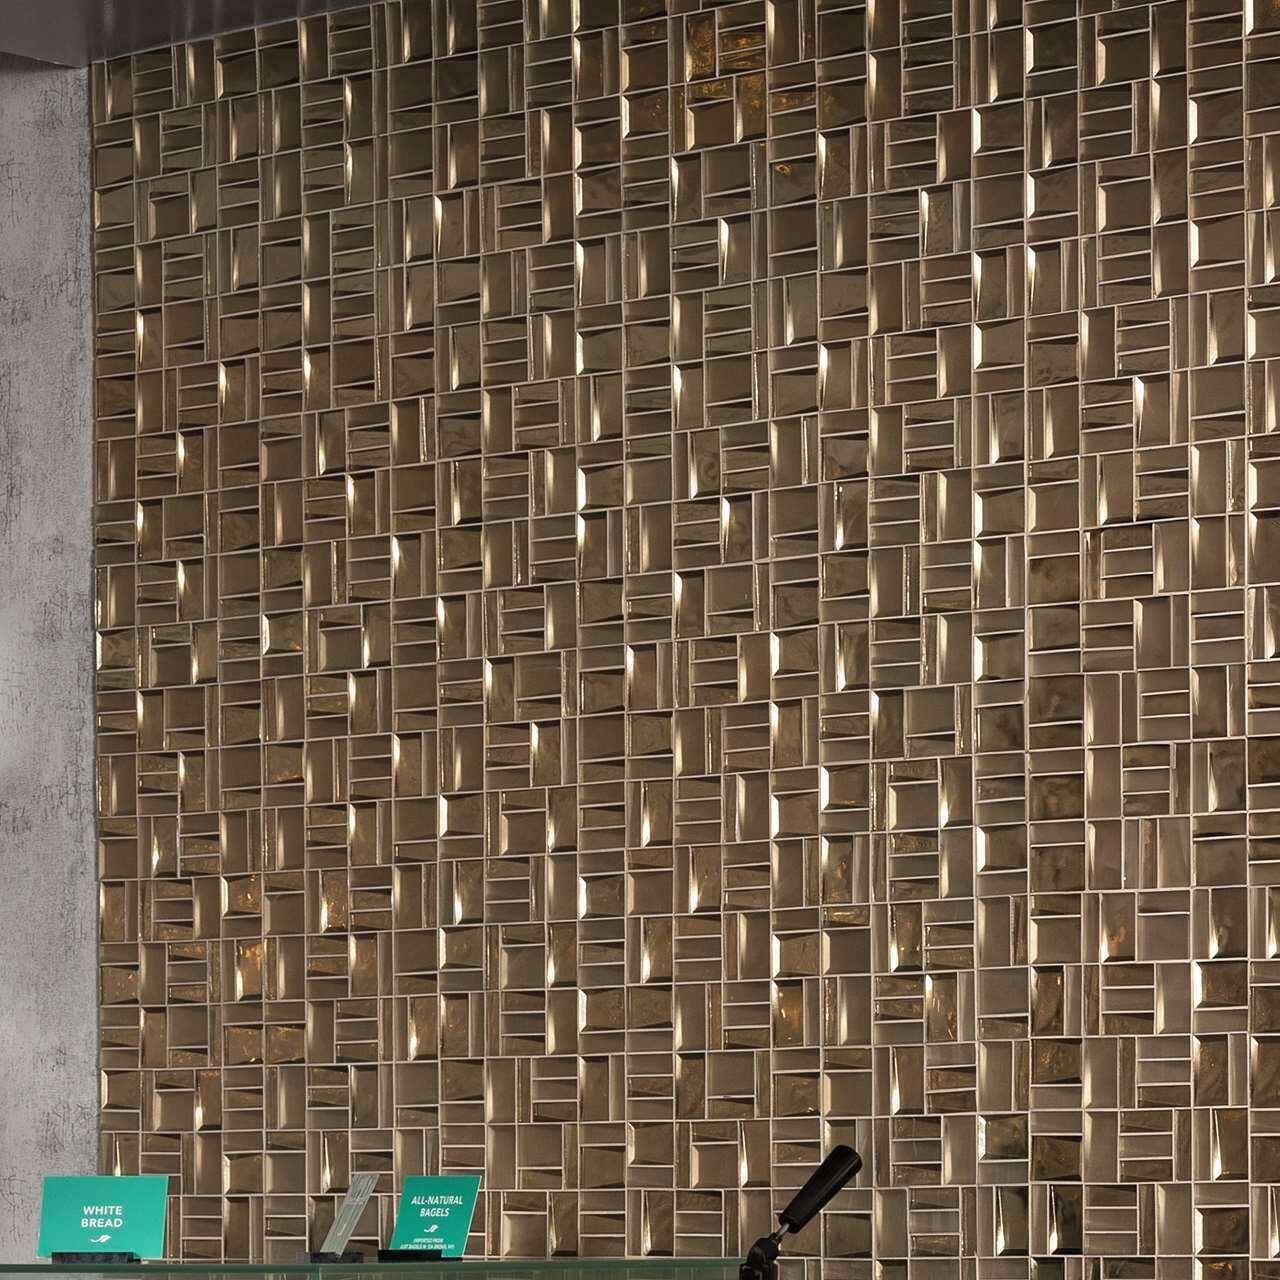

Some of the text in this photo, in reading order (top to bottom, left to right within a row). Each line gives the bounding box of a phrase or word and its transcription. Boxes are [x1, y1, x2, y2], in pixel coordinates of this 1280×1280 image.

[411, 1195, 463, 1205] ALL-NATURAL
[83, 1206, 123, 1215] WHITE
[420, 1207, 450, 1217] BAGELS
[81, 1218, 123, 1228] BREAD
